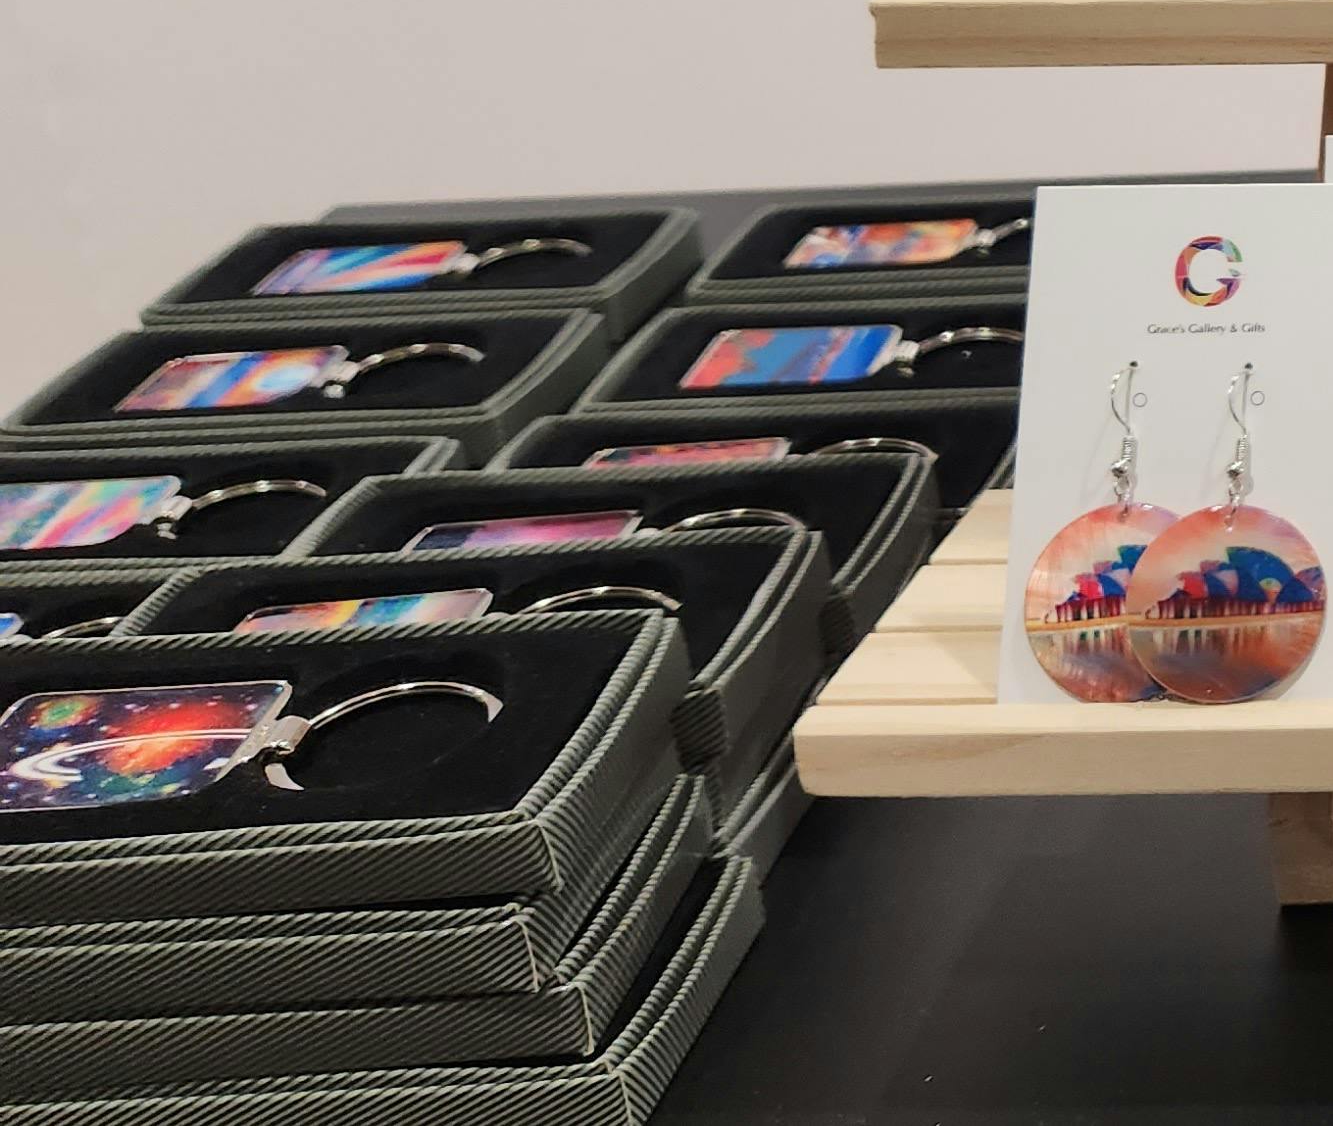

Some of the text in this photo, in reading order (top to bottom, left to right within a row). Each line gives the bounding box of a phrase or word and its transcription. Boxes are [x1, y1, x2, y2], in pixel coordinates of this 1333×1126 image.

[1147, 322, 1266, 335] Grace's Gallery & Gifts
